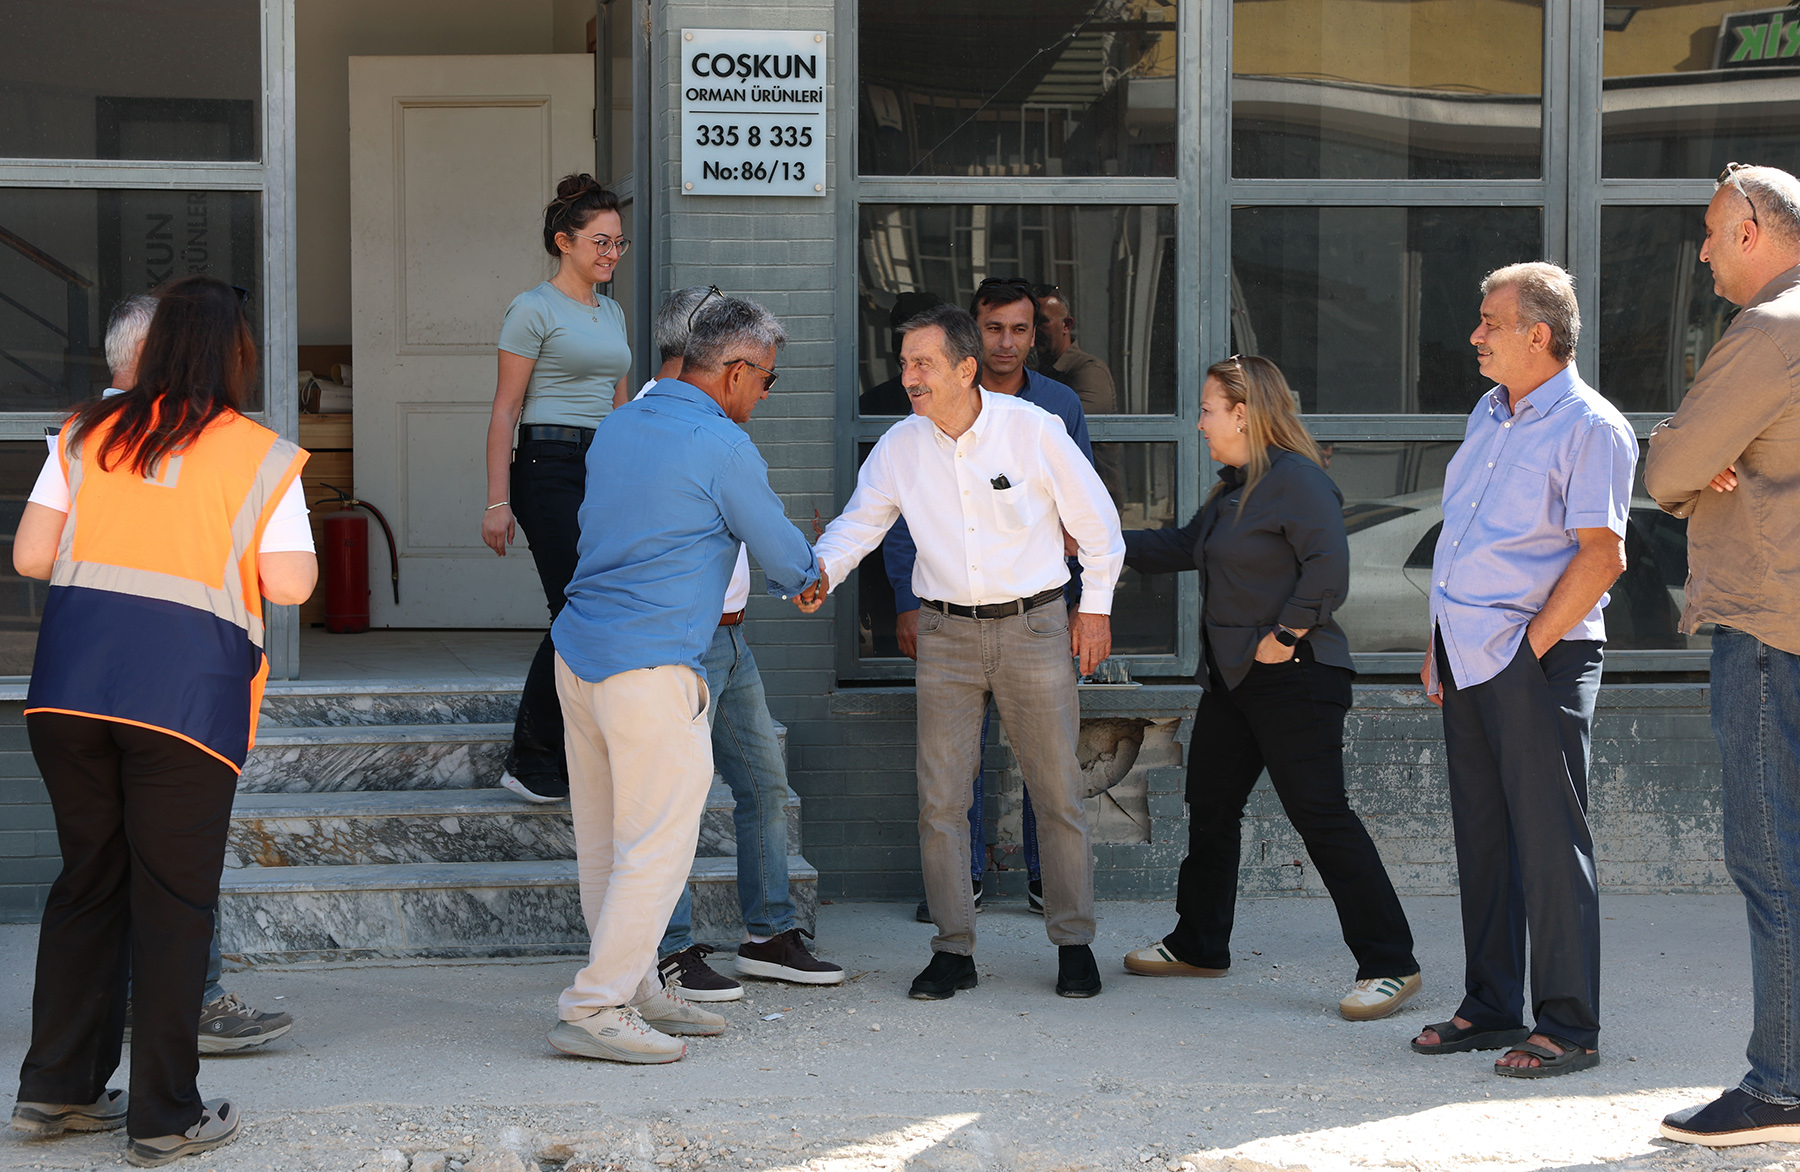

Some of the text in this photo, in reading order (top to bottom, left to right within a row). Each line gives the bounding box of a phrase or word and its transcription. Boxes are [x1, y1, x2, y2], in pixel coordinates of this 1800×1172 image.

[692, 53, 816, 83] COŞKUN
[686, 85, 823, 103] ORMAN ÜRÜNLERİ
[696, 125, 812, 147] 335 8 335
[703, 160, 806, 184] No:86/13
